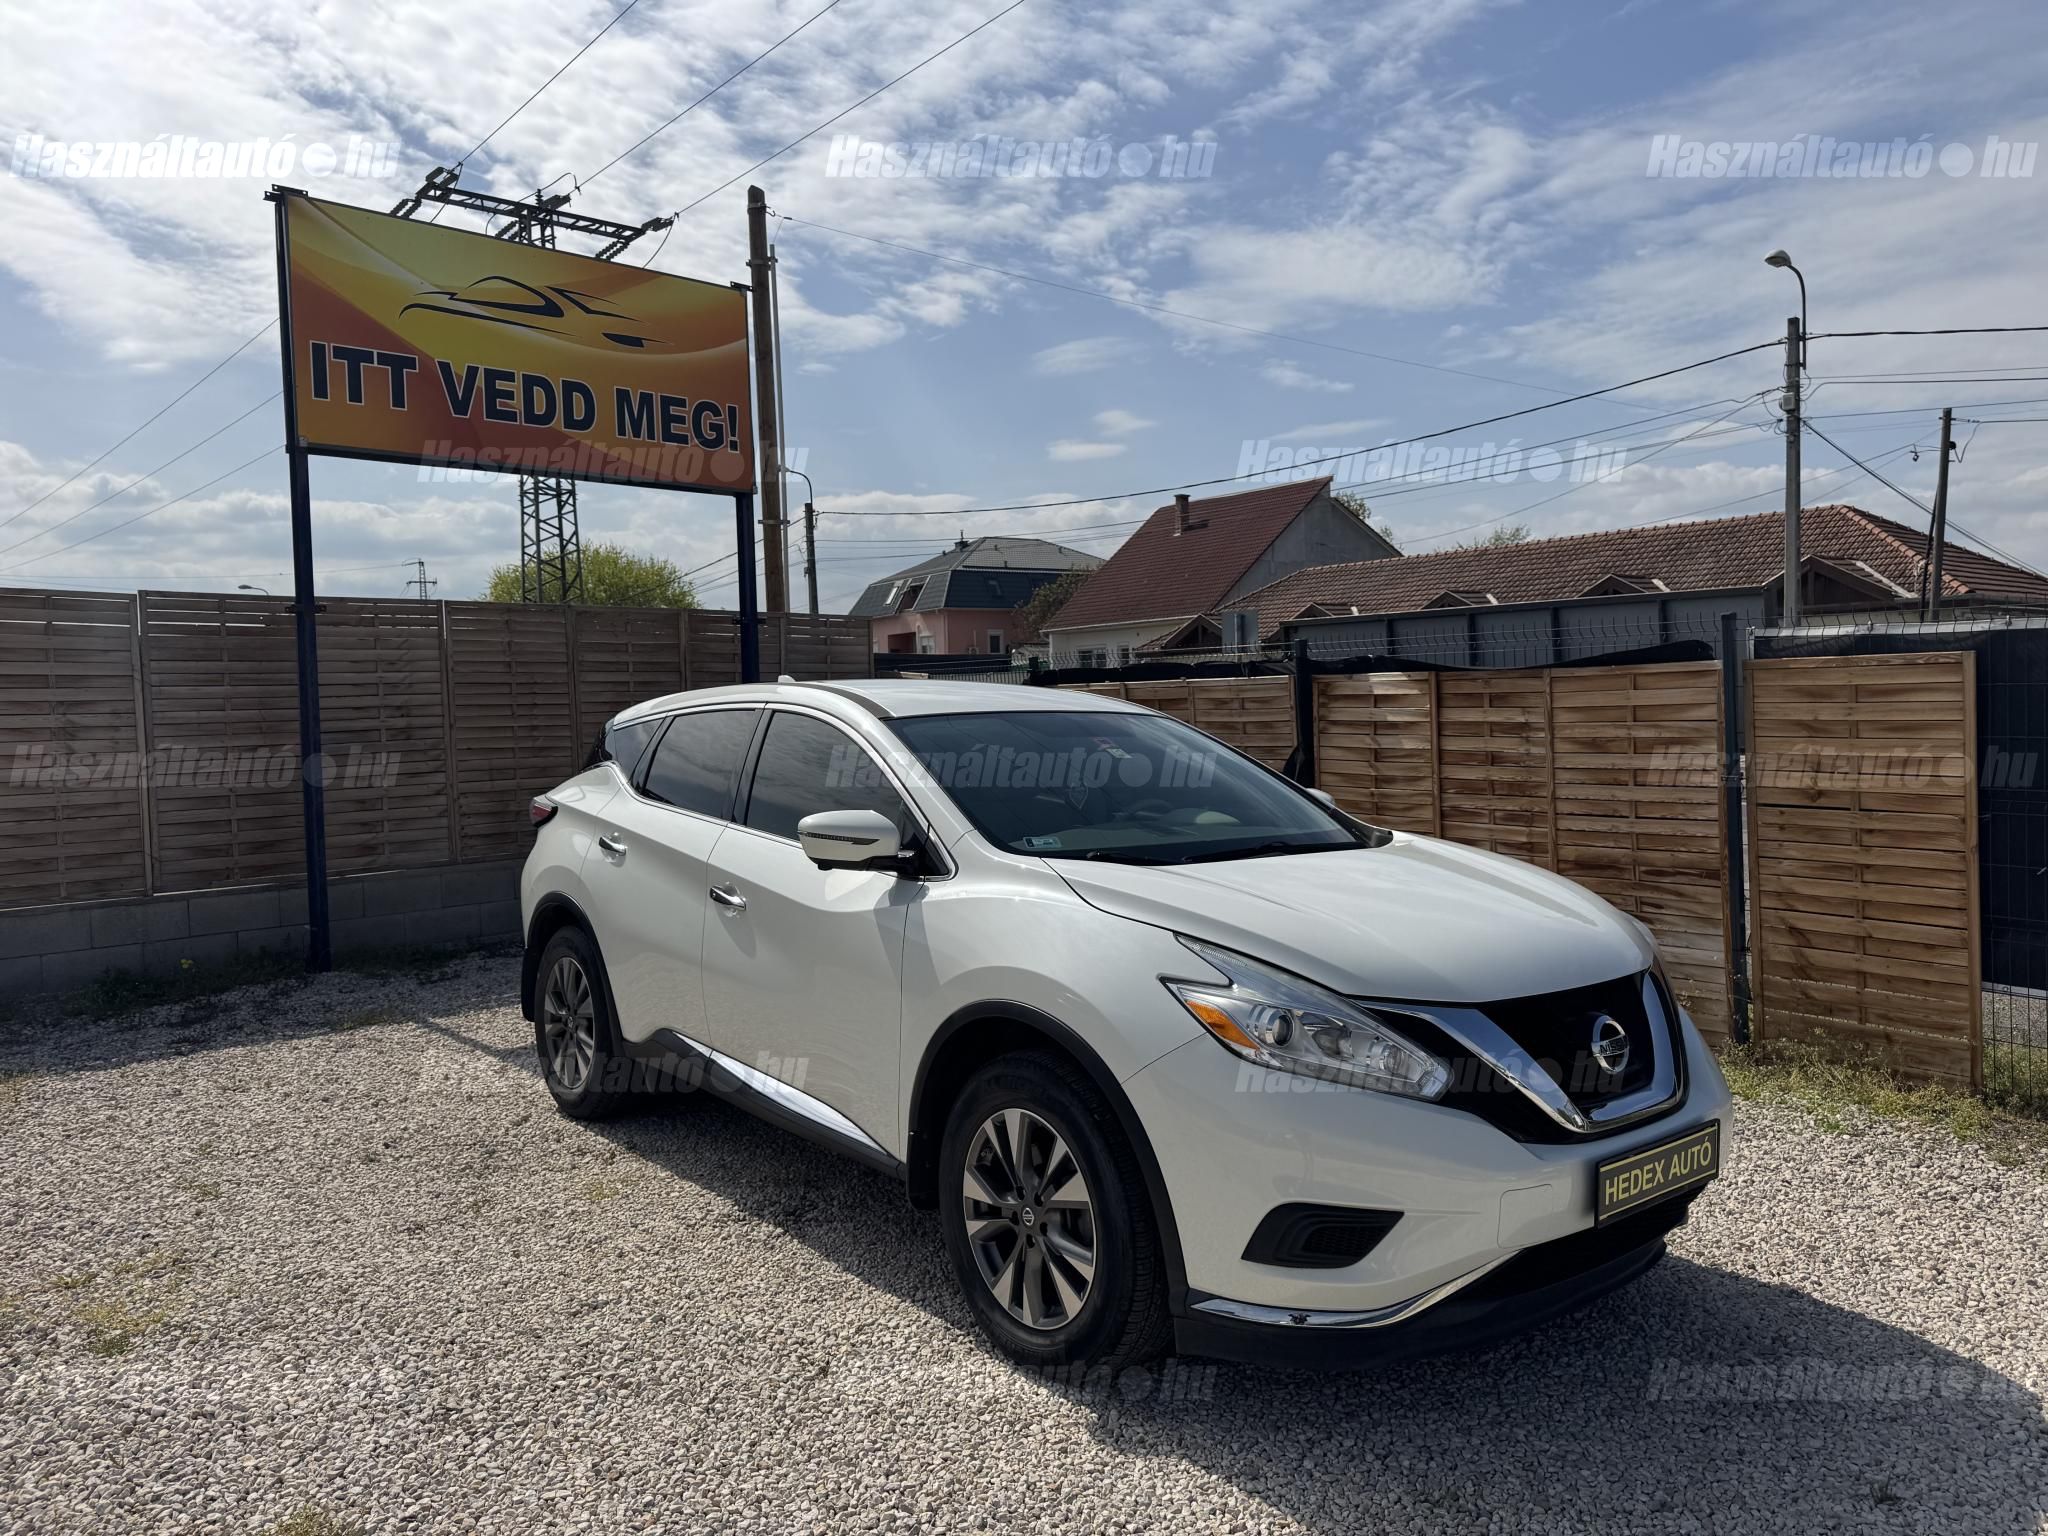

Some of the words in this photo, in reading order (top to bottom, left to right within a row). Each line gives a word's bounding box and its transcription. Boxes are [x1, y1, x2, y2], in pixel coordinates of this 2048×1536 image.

[308, 340, 419, 411] ITT
[435, 358, 598, 433] VEDD
[613, 384, 739, 454] MEG!
[1605, 1159, 1665, 1206] HEDEX
[1668, 1135, 1712, 1180] AUTÓ
